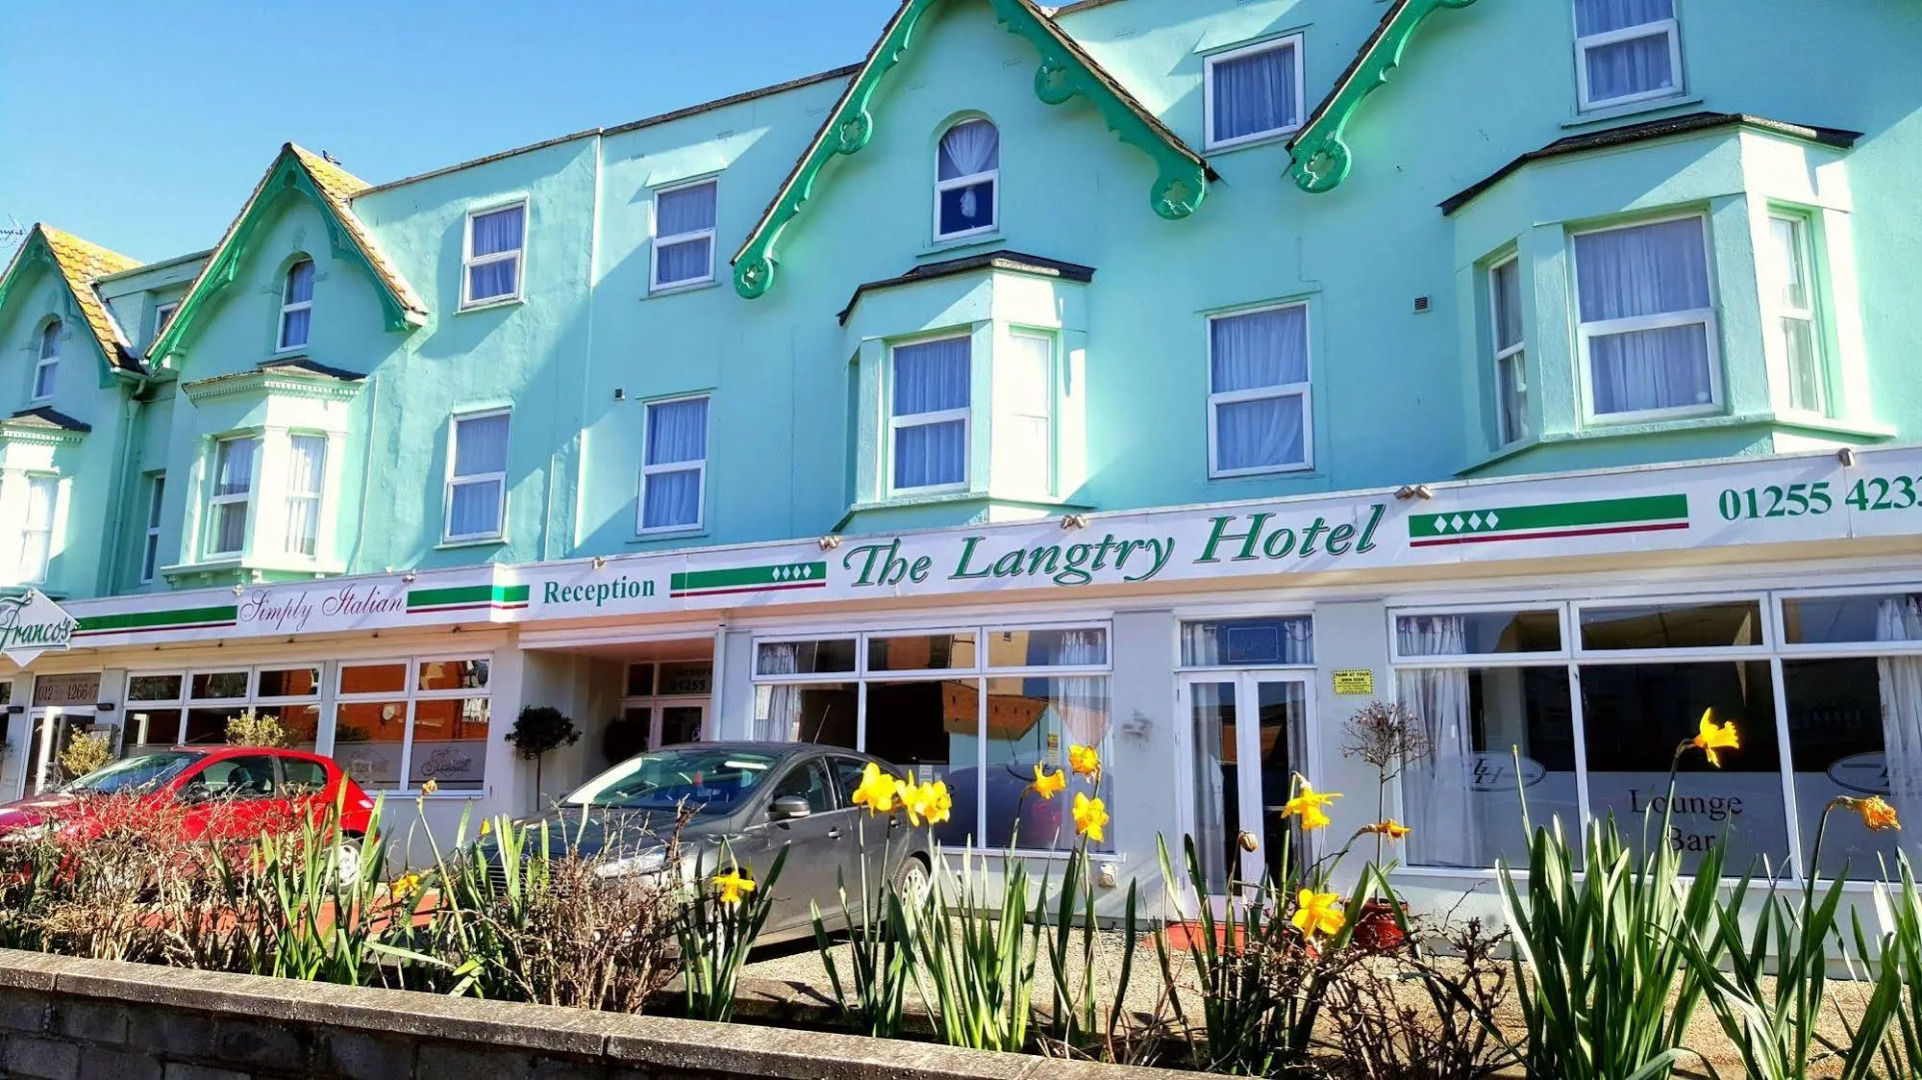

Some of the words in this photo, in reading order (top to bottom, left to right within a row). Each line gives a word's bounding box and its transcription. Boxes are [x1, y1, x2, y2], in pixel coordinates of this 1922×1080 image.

[1719, 482, 1832, 521] 01255
[1845, 476, 1922, 512] 423
[843, 538, 932, 587] The
[947, 534, 1175, 586] Langtry
[1192, 503, 1386, 564] Hotel
[239, 589, 313, 632] Simply
[321, 583, 403, 617] Italian
[543, 575, 655, 607] Reception
[0, 597, 71, 650] Franco's
[1628, 789, 1743, 821] Lounge
[1667, 826, 1715, 852] Bar
